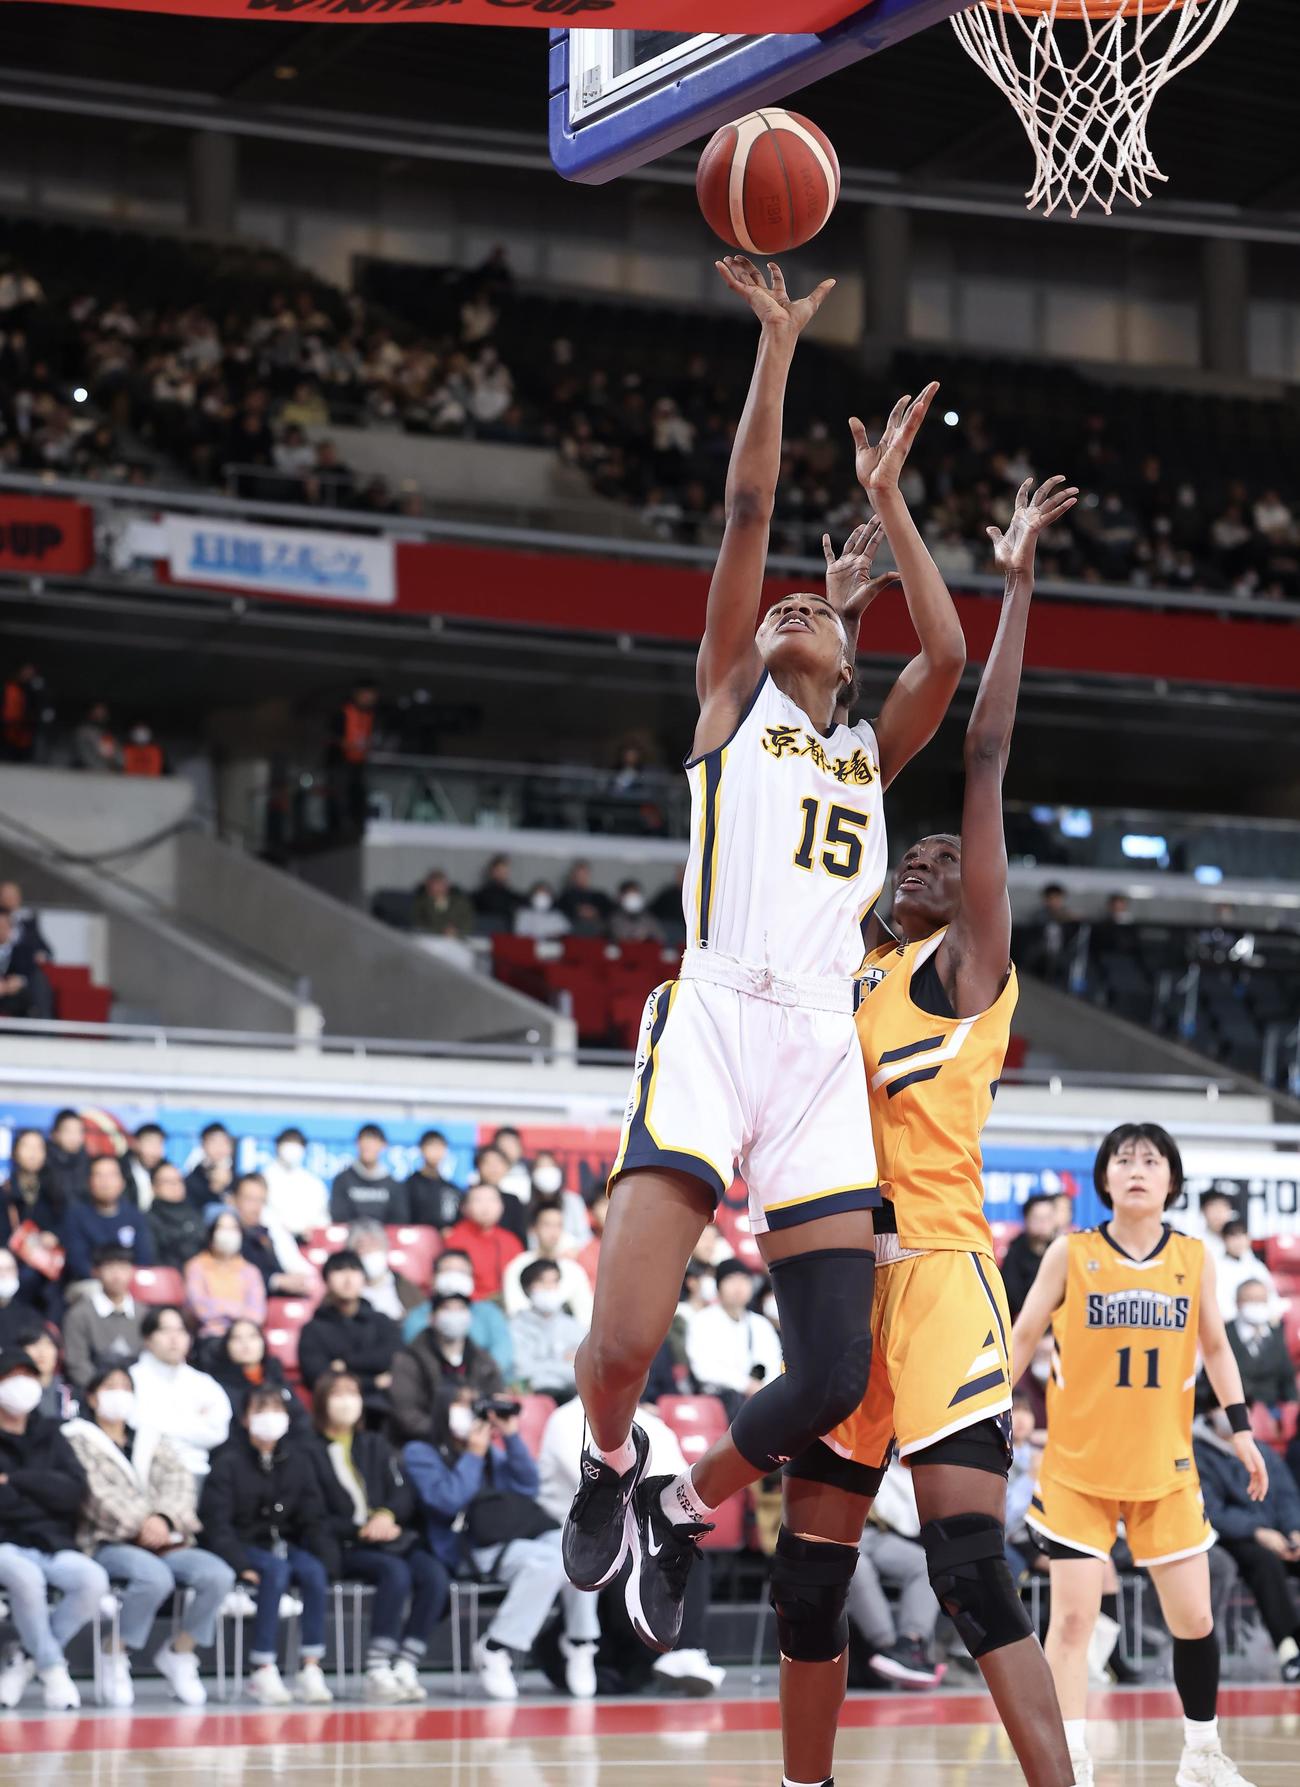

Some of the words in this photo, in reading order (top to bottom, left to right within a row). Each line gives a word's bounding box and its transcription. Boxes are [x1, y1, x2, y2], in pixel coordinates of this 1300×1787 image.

[0, 522, 63, 560] UP
[793, 797, 869, 880] 15
[1086, 1293, 1190, 1331] SEAGULLS
[1115, 1346, 1161, 1389] 11
